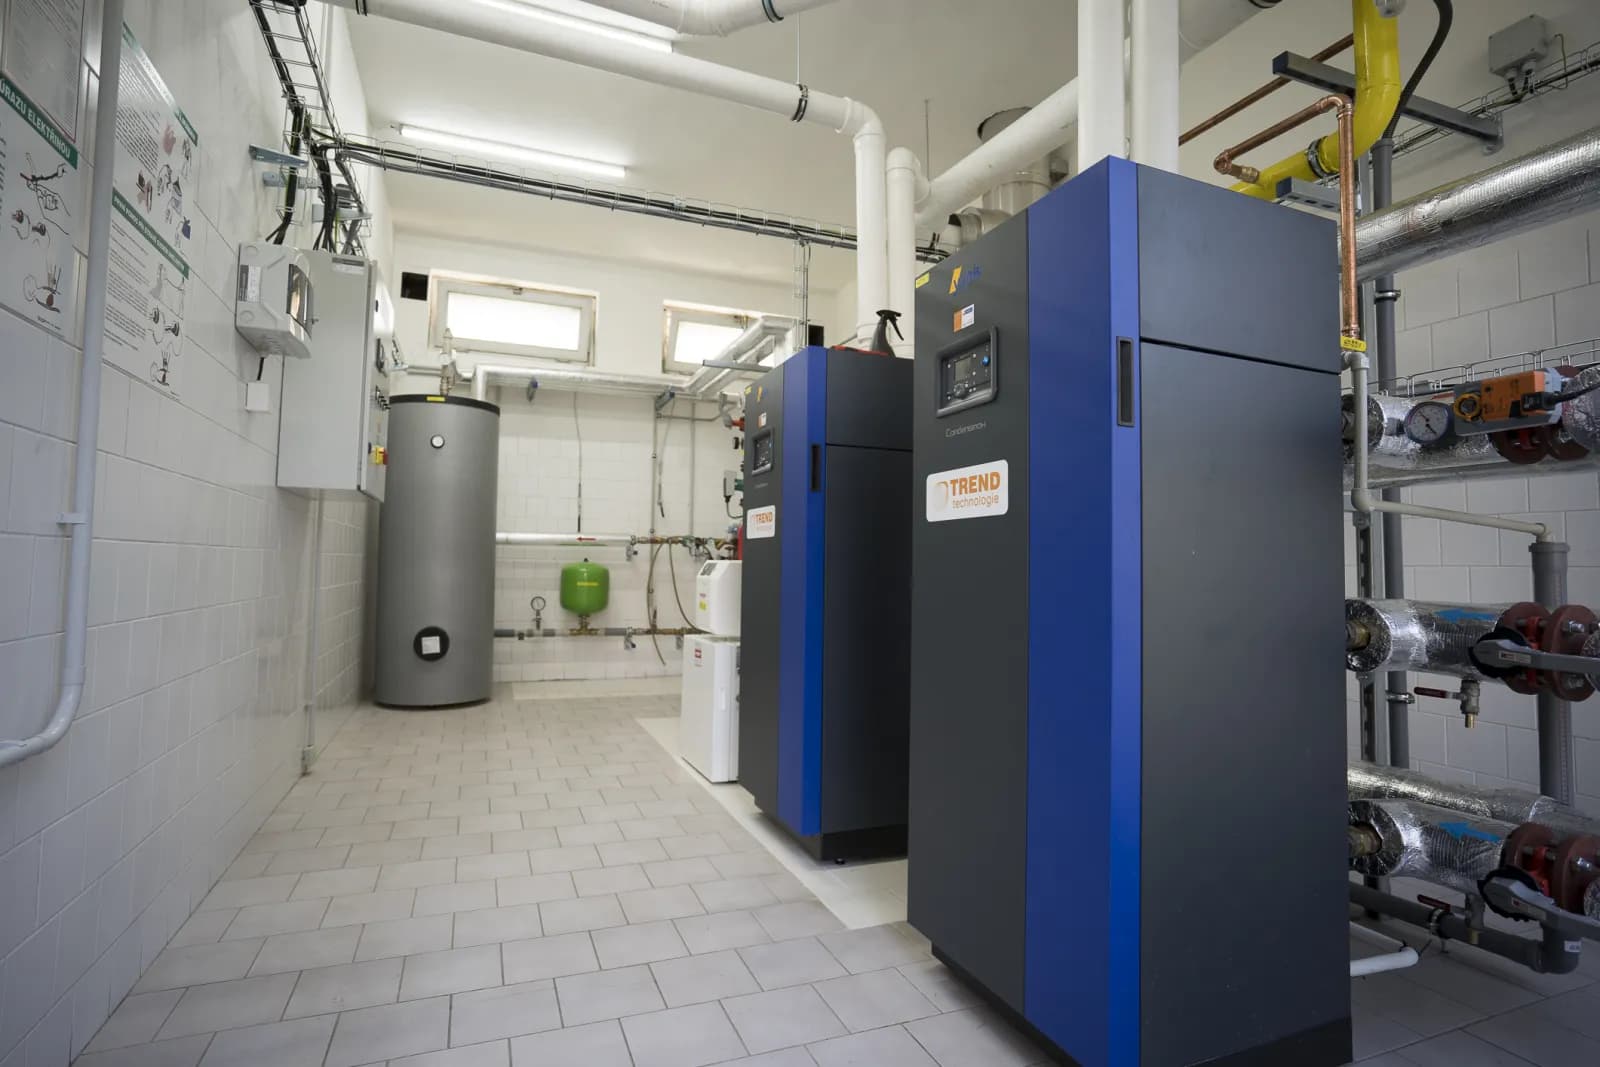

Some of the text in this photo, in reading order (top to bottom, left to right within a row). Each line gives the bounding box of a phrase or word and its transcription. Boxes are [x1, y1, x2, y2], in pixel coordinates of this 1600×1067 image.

[27, 109, 71, 158] ELEKTŘINOU
[950, 471, 1001, 496] TREND
[952, 494, 999, 509] technologie
